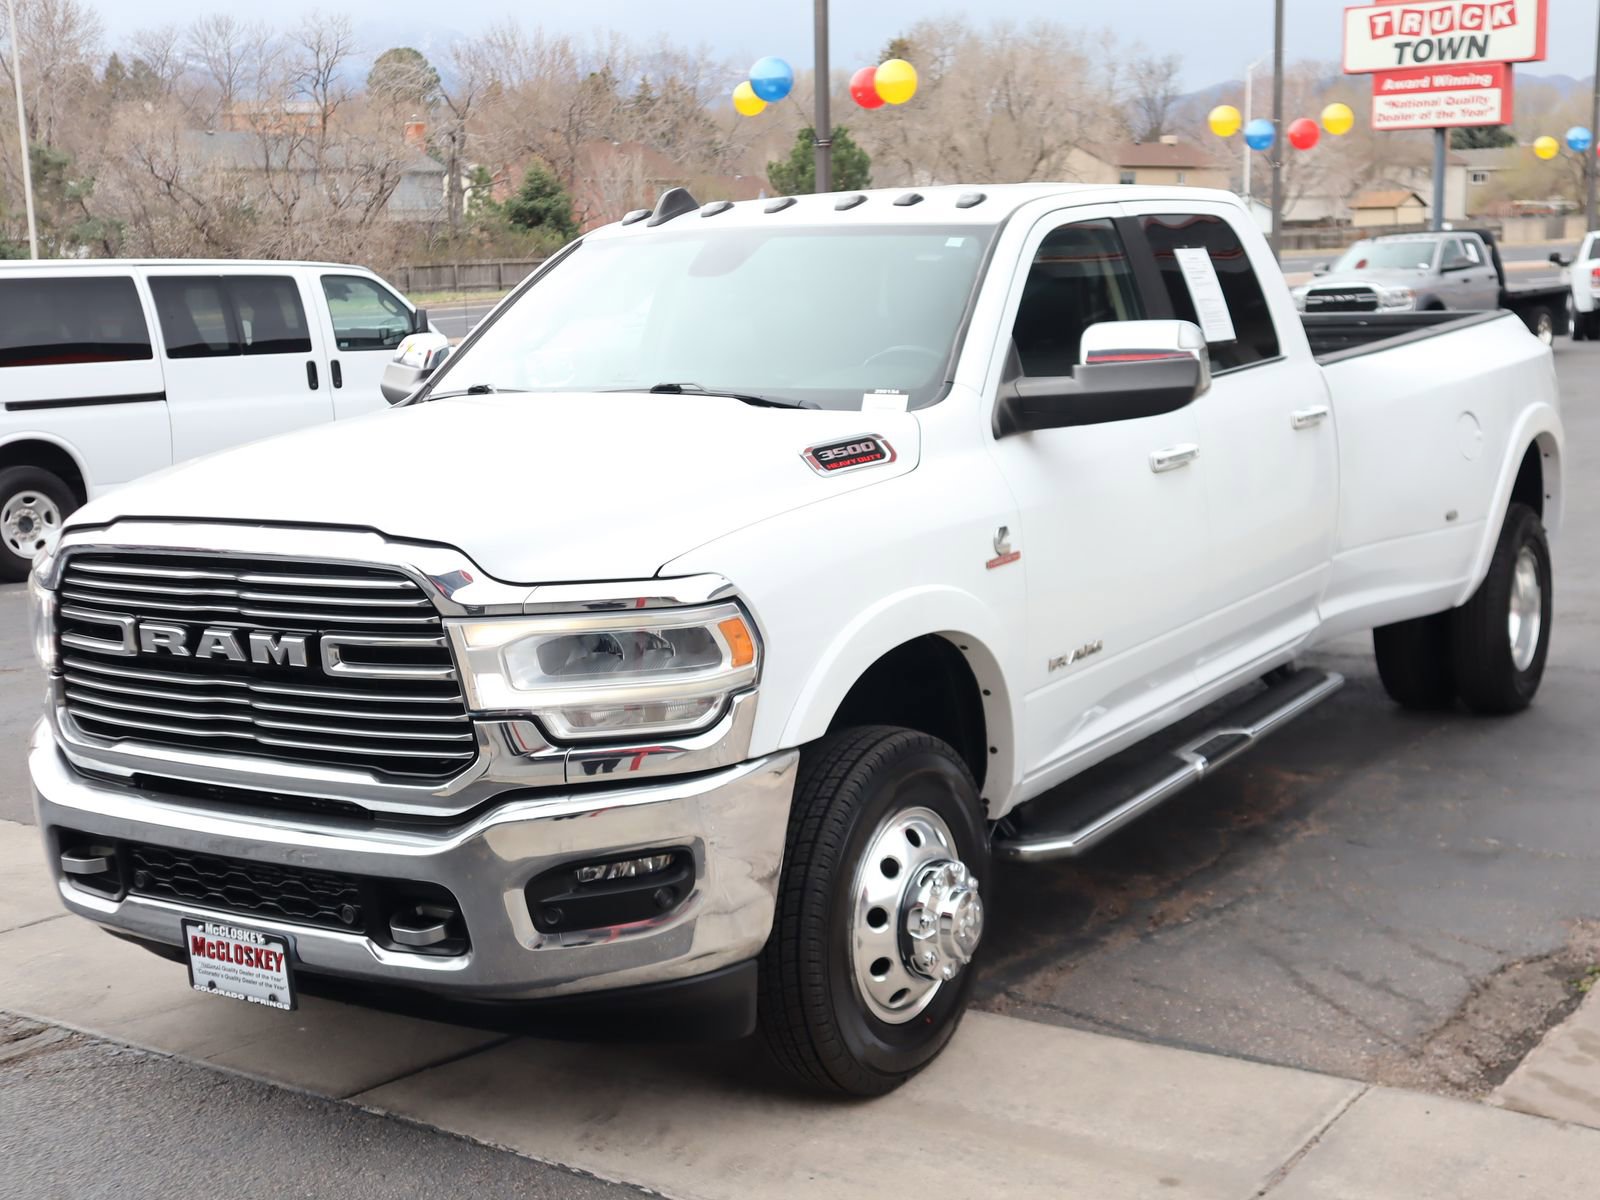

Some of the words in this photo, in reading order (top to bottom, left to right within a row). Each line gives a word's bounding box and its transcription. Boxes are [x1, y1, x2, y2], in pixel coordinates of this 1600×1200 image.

[1371, 3, 1515, 37] TRUCK
[1394, 34, 1490, 64] TOWN
[1382, 76, 1431, 90] Award
[1432, 73, 1493, 88] Winning
[1436, 109, 1457, 119] the
[818, 441, 876, 461] 3500
[826, 458, 856, 469] HEAVY
[857, 453, 882, 463] DUTY
[139, 622, 308, 668] RAM
[205, 922, 263, 944] McCLOSKEY
[191, 935, 284, 973] McCLOSKEY
[222, 965, 238, 974] Quality
[239, 969, 254, 977] Dealer
[225, 973, 241, 983] Quality
[242, 977, 257, 985] Dealer
[193, 984, 245, 1000] COLORADO
[247, 995, 291, 1011] SPRINGS
